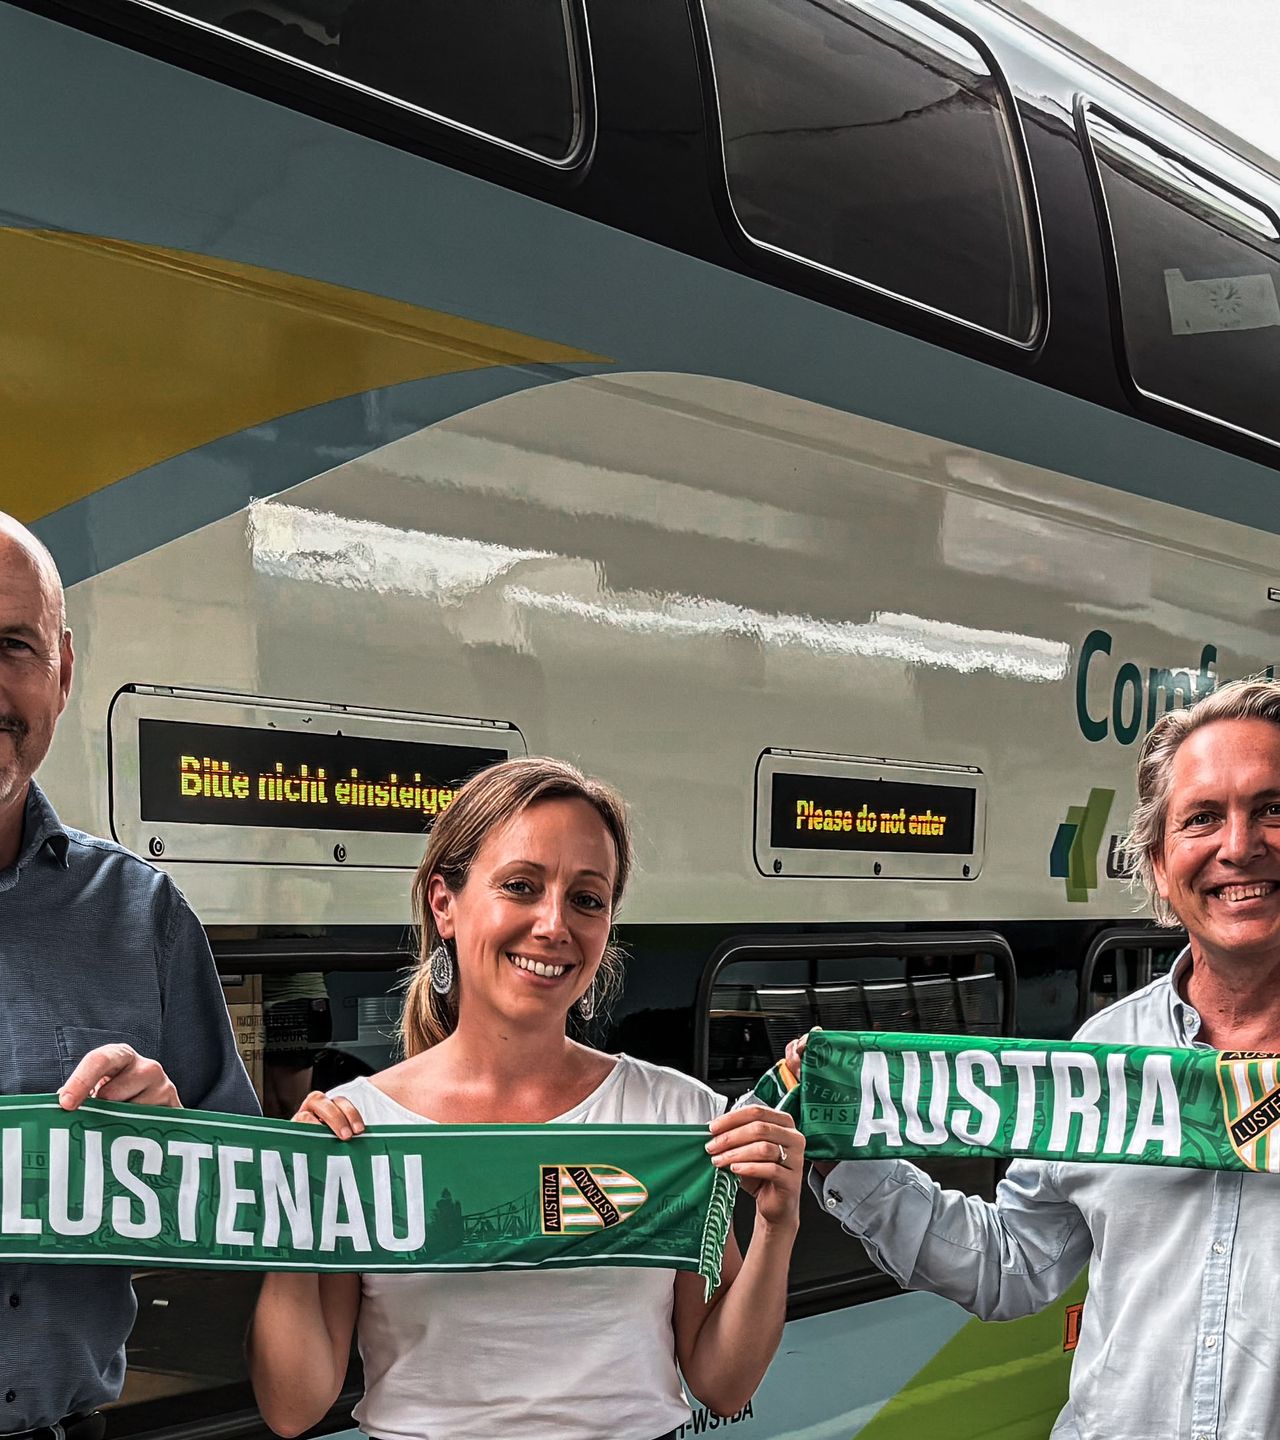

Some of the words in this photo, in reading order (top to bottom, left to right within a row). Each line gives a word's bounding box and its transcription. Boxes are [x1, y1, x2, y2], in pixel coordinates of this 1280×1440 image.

[1076, 629, 1274, 745] Comf
[180, 755, 250, 798] Bitte
[258, 762, 328, 803] nicht
[796, 800, 853, 832] Please
[856, 803, 877, 832] do
[880, 808, 906, 834] not
[909, 810, 947, 836] enter
[851, 1050, 1182, 1157] AUSTRIA
[1, 1126, 426, 1253] LUSTENAU
[544, 1172, 558, 1228] AUSTRIA
[572, 1168, 619, 1223] USTENAU
